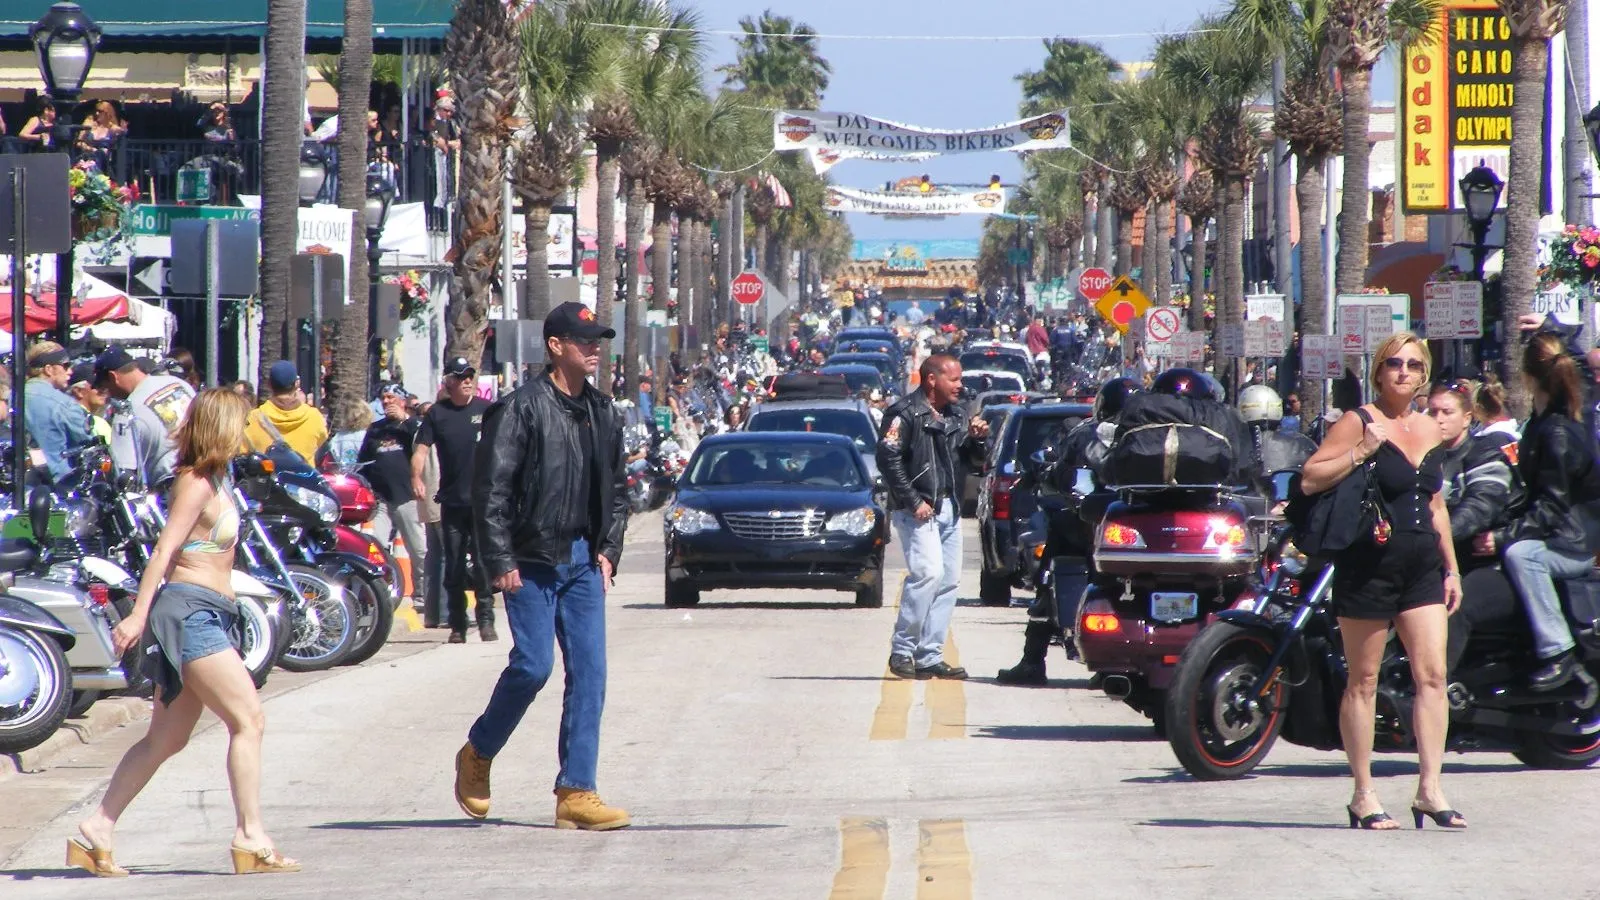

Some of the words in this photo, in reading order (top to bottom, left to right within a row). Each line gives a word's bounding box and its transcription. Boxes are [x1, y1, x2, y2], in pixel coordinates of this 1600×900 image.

[1456, 50, 1512, 74] CANO
[823, 132, 937, 150] WELCOMES
[945, 133, 1015, 150] BIKERS
[733, 282, 762, 295] STOP
[1081, 276, 1110, 290] STOP
